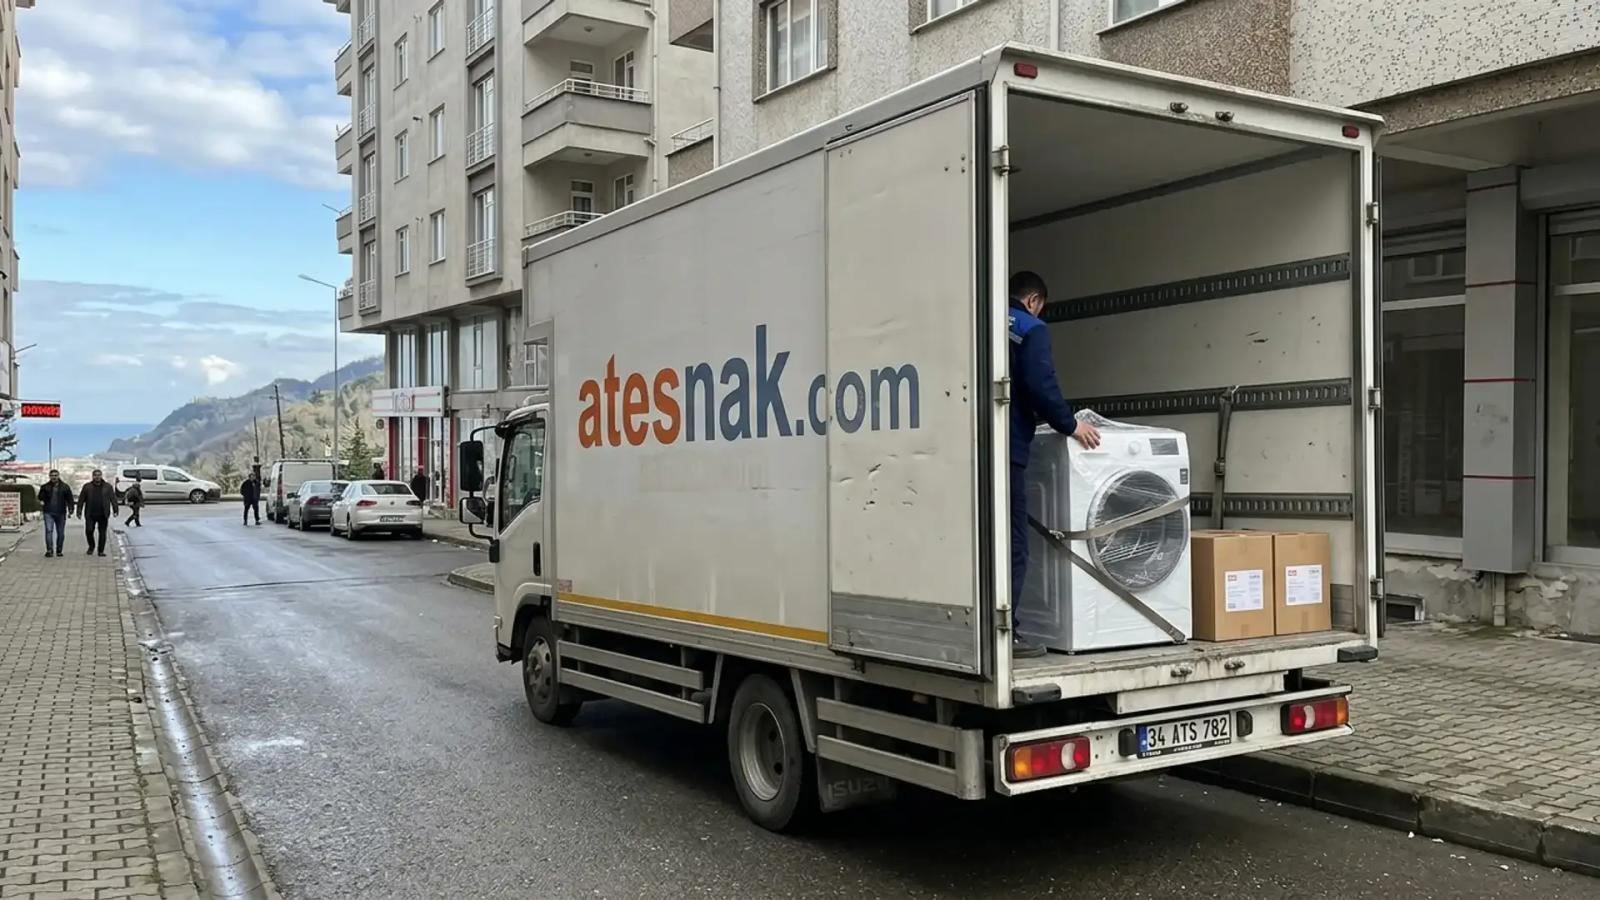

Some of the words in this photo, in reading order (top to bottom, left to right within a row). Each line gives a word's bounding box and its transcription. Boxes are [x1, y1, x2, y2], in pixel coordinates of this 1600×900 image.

[578, 324, 920, 448] atesnak.com
[1148, 727, 1165, 747] 34
[1172, 722, 1197, 744] ATS
[1203, 717, 1228, 739] 782
[827, 778, 887, 797] ISUZ
